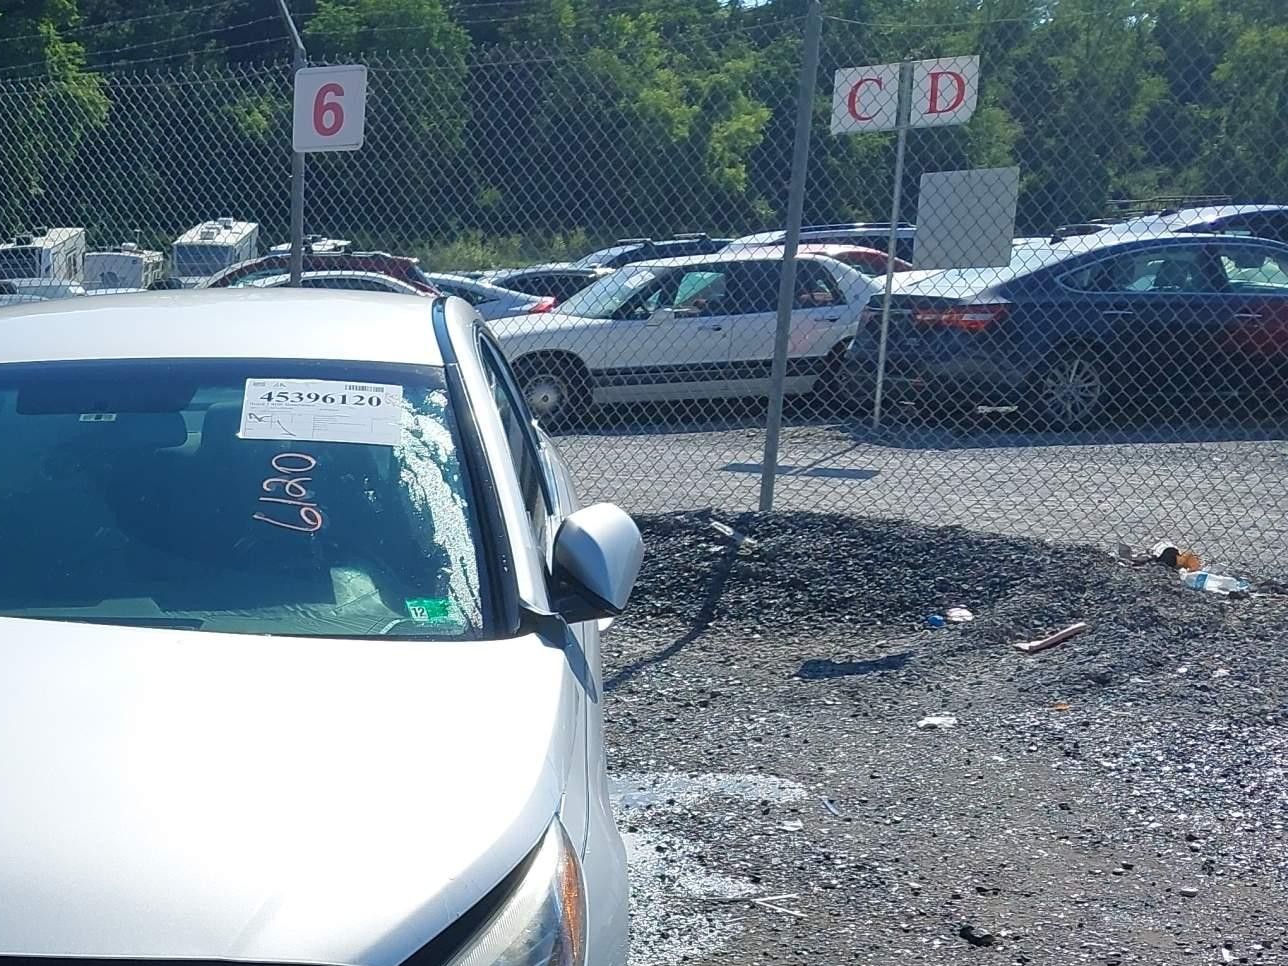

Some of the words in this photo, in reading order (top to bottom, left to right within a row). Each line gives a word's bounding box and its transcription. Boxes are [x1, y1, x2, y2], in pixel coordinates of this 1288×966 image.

[313, 83, 344, 136] 6
[847, 77, 883, 121] C
[923, 71, 966, 114] D
[259, 391, 382, 407] 45396120
[253, 452, 323, 532] 6120
